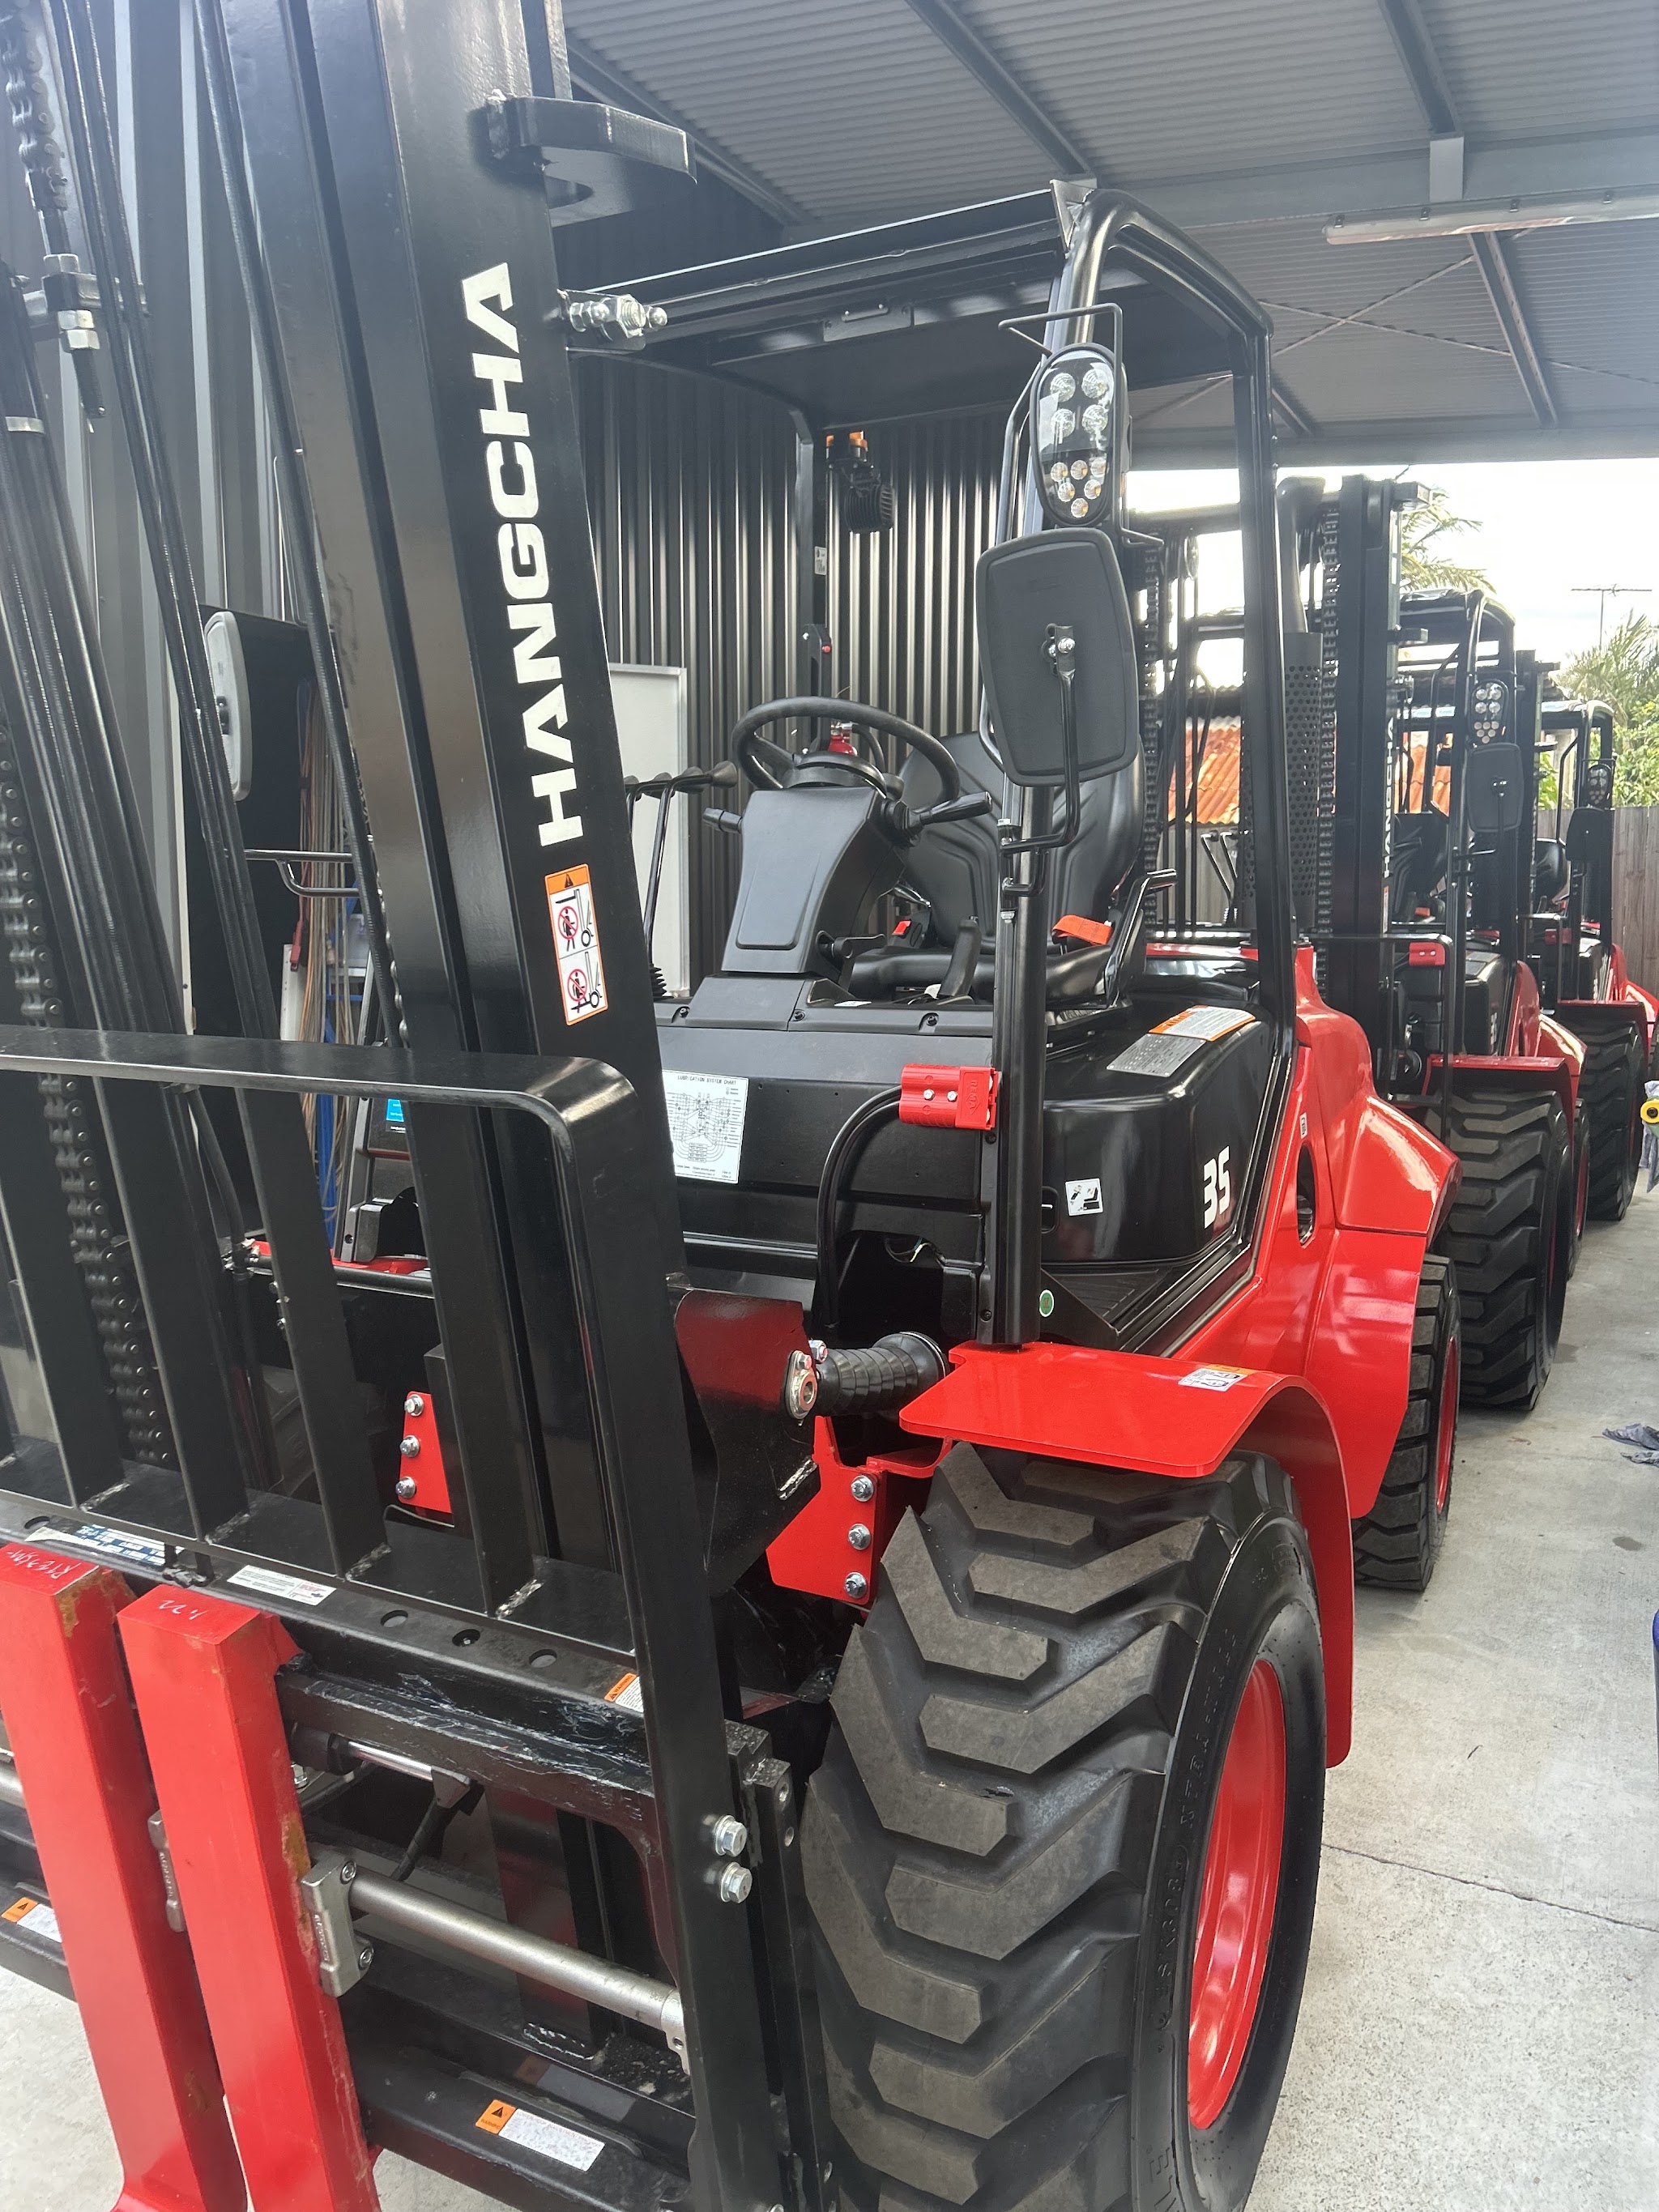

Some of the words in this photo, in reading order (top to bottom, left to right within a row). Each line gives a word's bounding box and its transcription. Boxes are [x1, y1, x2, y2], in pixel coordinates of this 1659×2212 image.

[462, 262, 584, 846] HANGCHA
[1384, 717, 1394, 878] HANGCHA
[970, 1080, 978, 1110] REMA
[1203, 1145, 1230, 1229] 35
[615, 1674, 633, 1693] WARNING
